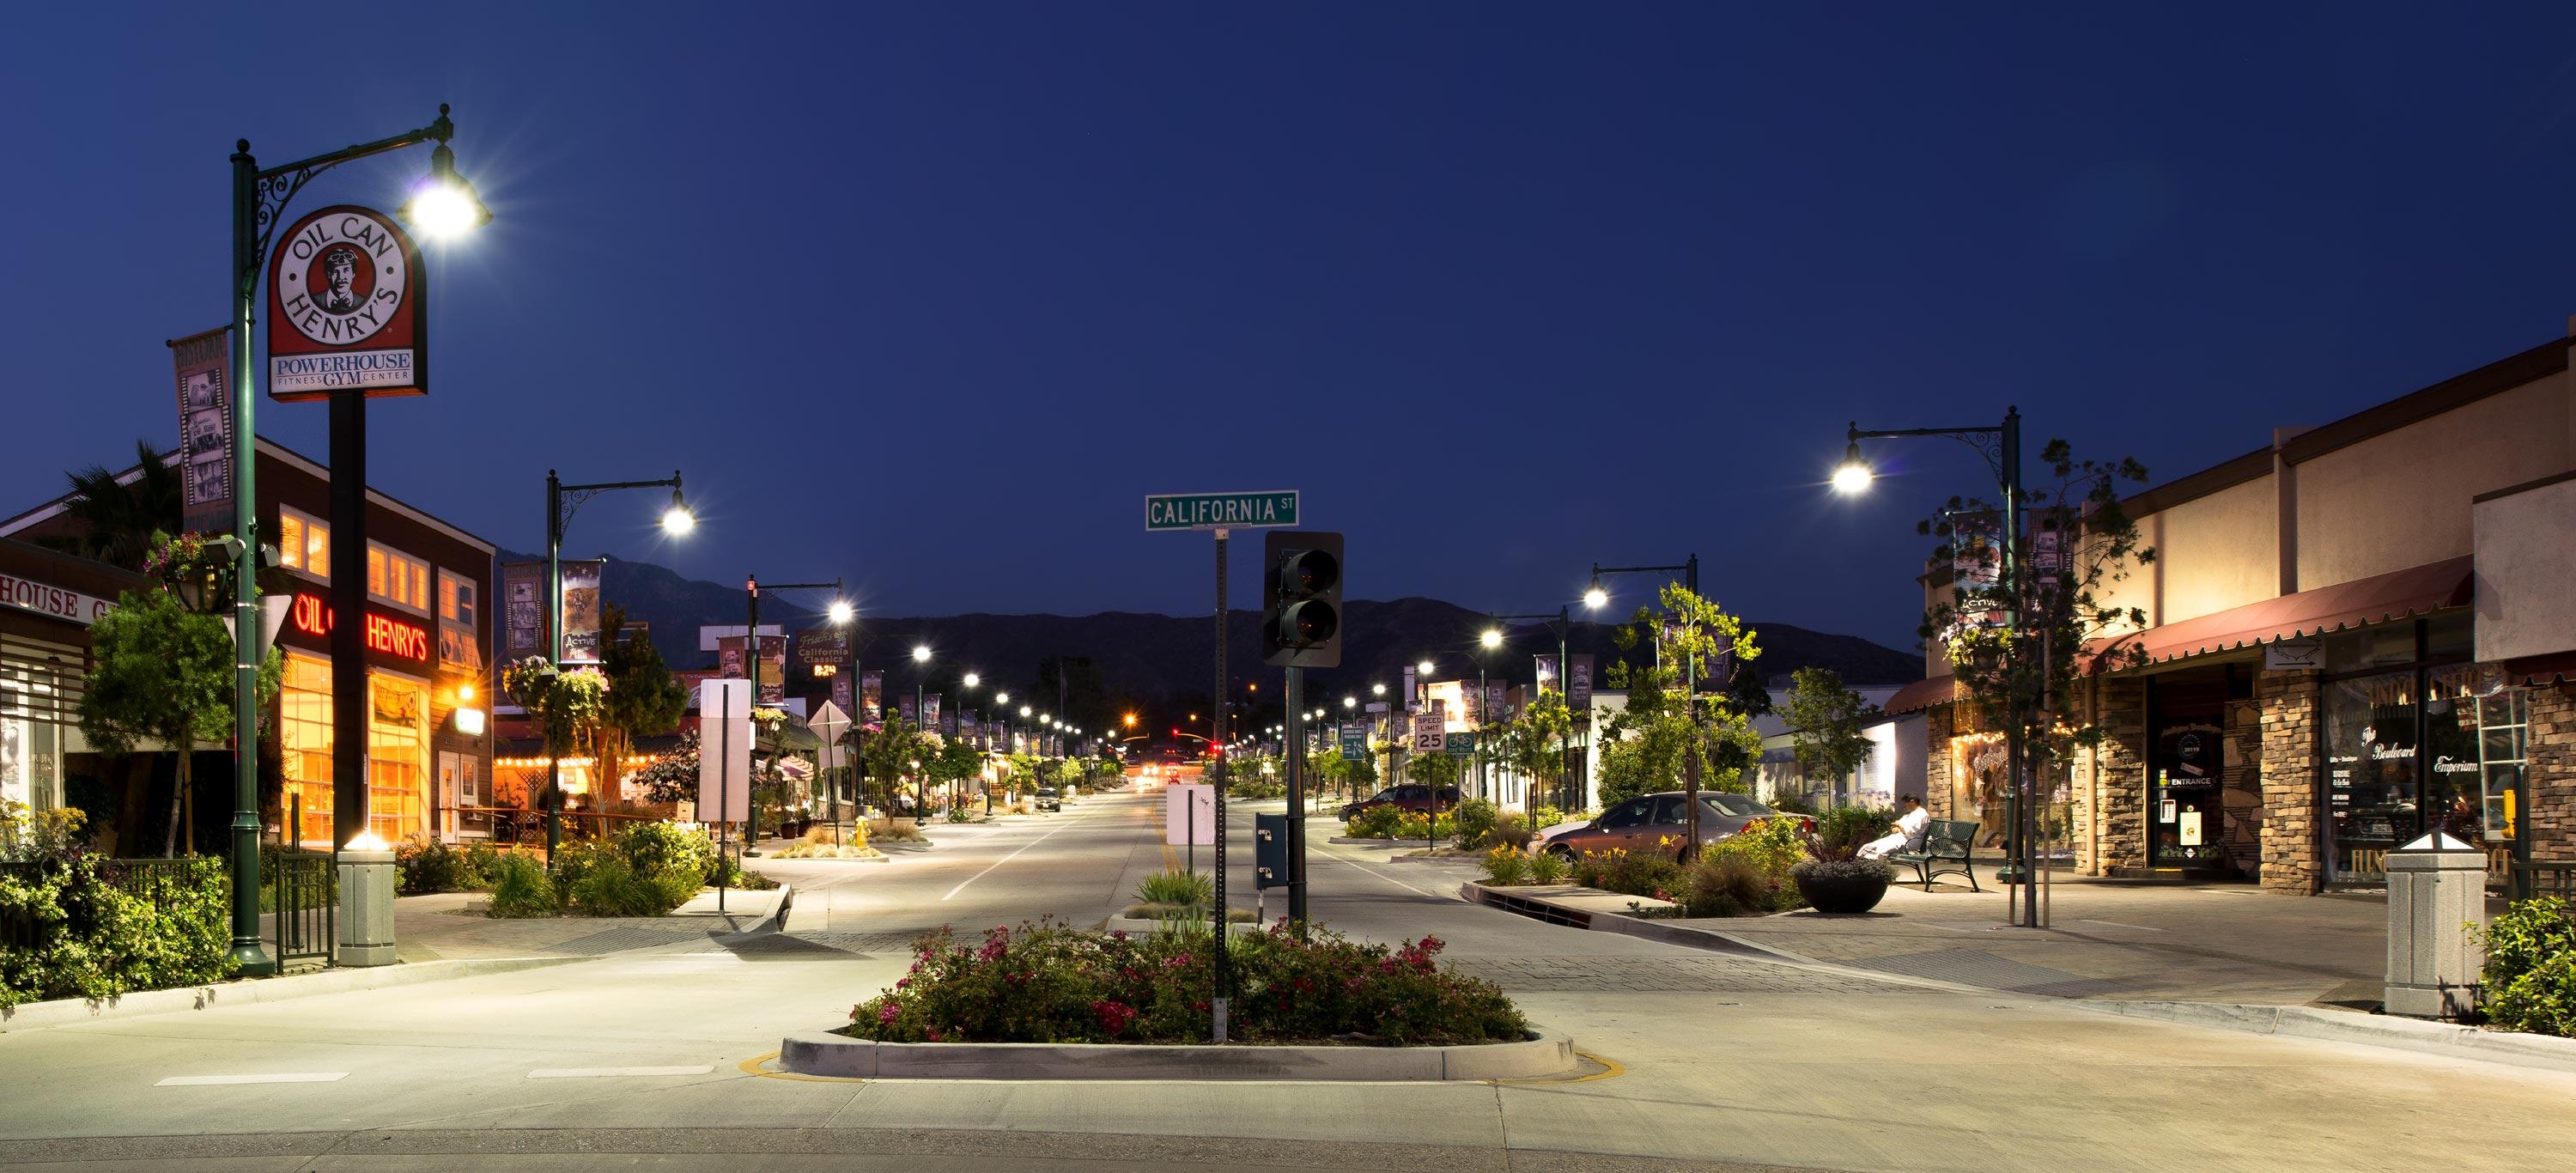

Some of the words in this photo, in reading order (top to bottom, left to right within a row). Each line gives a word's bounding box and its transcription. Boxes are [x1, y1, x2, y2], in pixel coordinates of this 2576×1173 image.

[292, 223, 333, 260] OIL
[341, 216, 393, 258] CAN
[287, 288, 398, 341] HENRY'S
[276, 353, 410, 374] POWERHOUSE
[278, 376, 322, 386] FITNESS
[323, 372, 362, 386] GYM
[363, 372, 409, 381] CENTER
[1151, 498, 1275, 524] CALIFORNIA
[1280, 497, 1294, 509] ST
[295, 593, 325, 635] OIL
[367, 613, 427, 661] HENRY'S
[798, 647, 848, 656] California
[803, 655, 843, 664] Classics
[1419, 733, 1442, 748] 25
[2361, 726, 2377, 747] The
[2372, 742, 2417, 760] Boulevard
[2433, 756, 2479, 776] Emporium
[2172, 777, 2211, 786] ENTRANCE
